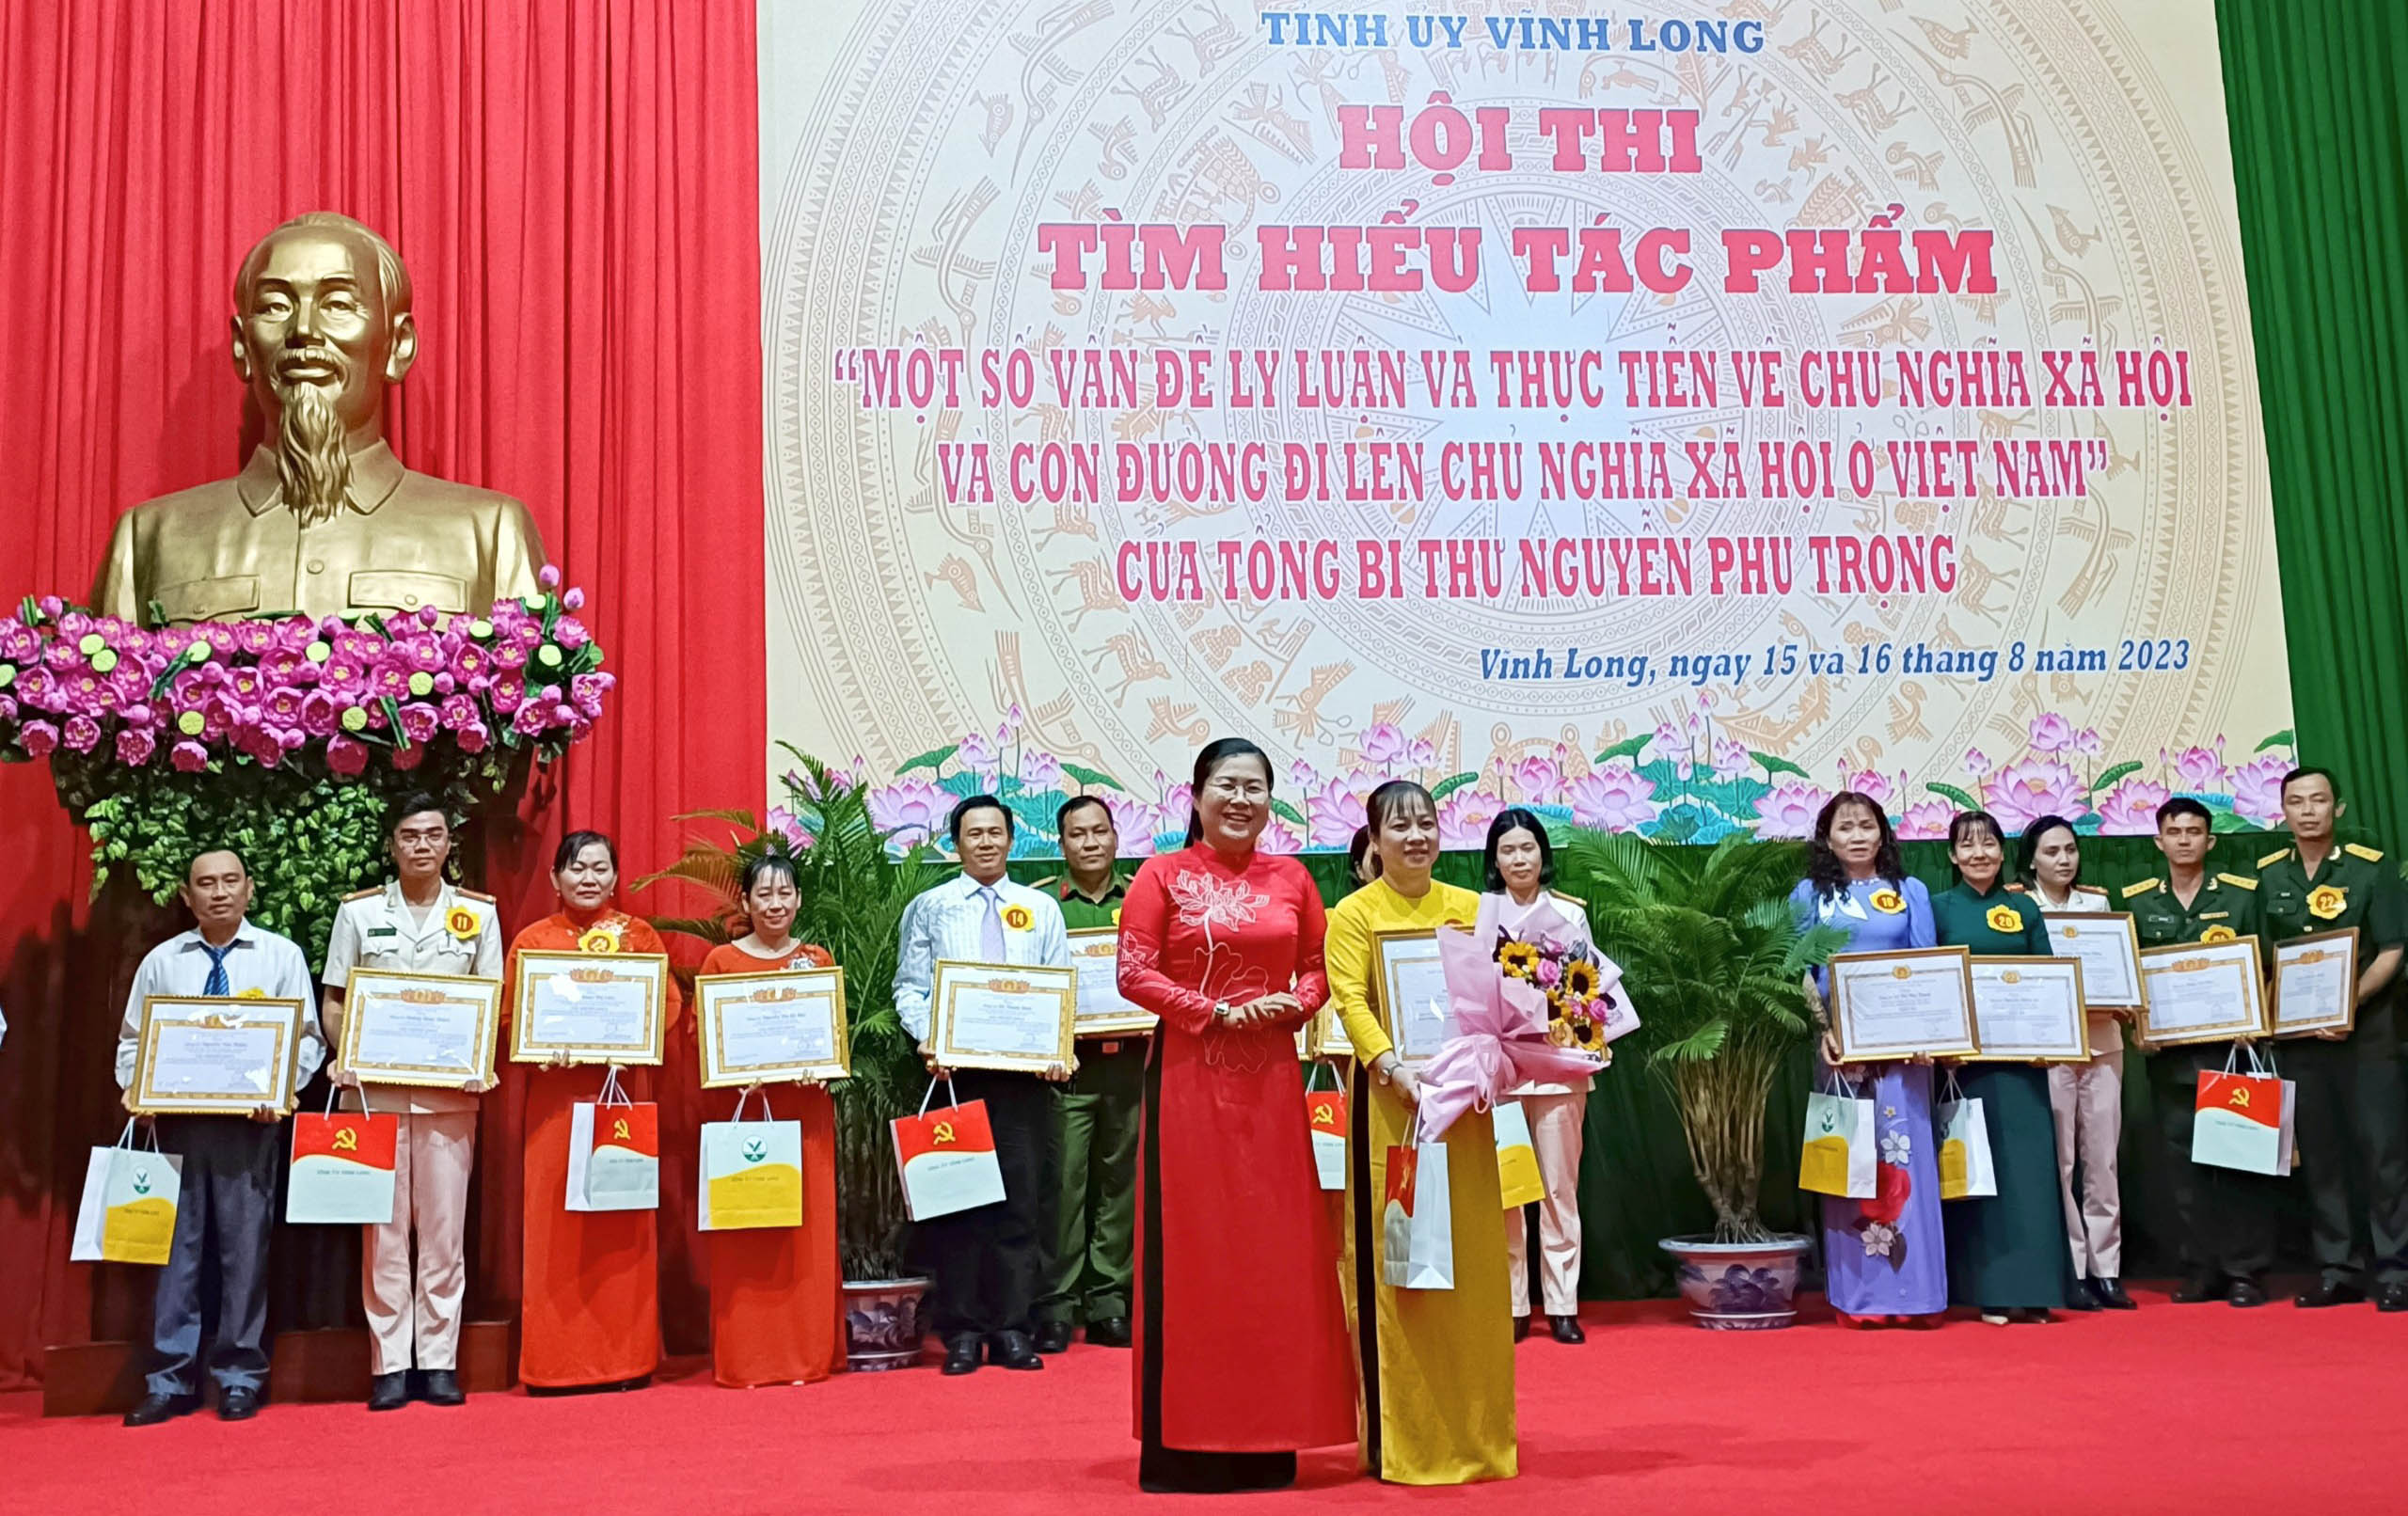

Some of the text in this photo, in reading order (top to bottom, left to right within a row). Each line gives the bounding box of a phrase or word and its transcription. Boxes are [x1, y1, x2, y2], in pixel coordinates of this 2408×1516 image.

[1261, 3, 1387, 46] TỈNH
[1484, 8, 1610, 51] VĨNH
[1628, 20, 1765, 54] LONG
[1338, 90, 1703, 185] HỘI THI
[1038, 199, 1998, 293] TÌM HIỂU TÁC PHẨM
[981, 325, 1035, 409] SỐ
[1050, 326, 1138, 409] VẤN
[1155, 324, 1213, 408] ĐỀ
[1228, 335, 1280, 408] LÝ
[1295, 336, 1406, 423] LUẬN
[1420, 335, 1477, 408] VÀ
[1490, 349, 1605, 422] THỰC
[1618, 323, 1718, 408] TIỄN
[1731, 326, 1784, 408] VỀ
[1799, 334, 1881, 408] CHỦ
[1895, 337, 2032, 408] NGHĨA
[2041, 337, 2105, 407] XÃ
[2115, 336, 2194, 421] HỘI
[938, 428, 994, 503] VÀ
[1010, 442, 1100, 503] CON
[1116, 427, 1268, 503] ĐƯỜNG
[1283, 443, 1330, 501] ĐI
[1343, 428, 1424, 501] LÊN
[1440, 424, 1524, 501] CHỦ
[1538, 428, 1673, 501] NGHĨA
[1685, 428, 1747, 499] XÃ
[1758, 427, 1835, 513] HỘI
[1848, 423, 1876, 498] Ở
[1887, 426, 1980, 513] VIỆT
[1117, 509, 1956, 608] CỦA TỔNG BÍ THƯ NGUYỄN PHÚ TRỌNG
[1481, 647, 1552, 680] Vĩnh
[1563, 648, 1657, 687] Long,
[1669, 646, 1751, 687] ngày
[1764, 644, 1798, 675] 15
[1809, 644, 1845, 675] và
[1858, 643, 1892, 674] 16
[2008, 641, 2025, 672] 8
[2036, 643, 2107, 671] năm
[2118, 640, 2190, 671] 2023
[457, 915, 468, 930] 11
[1011, 911, 1024, 925] 14
[1998, 915, 2013, 927] 20
[2320, 895, 2335, 911] 22
